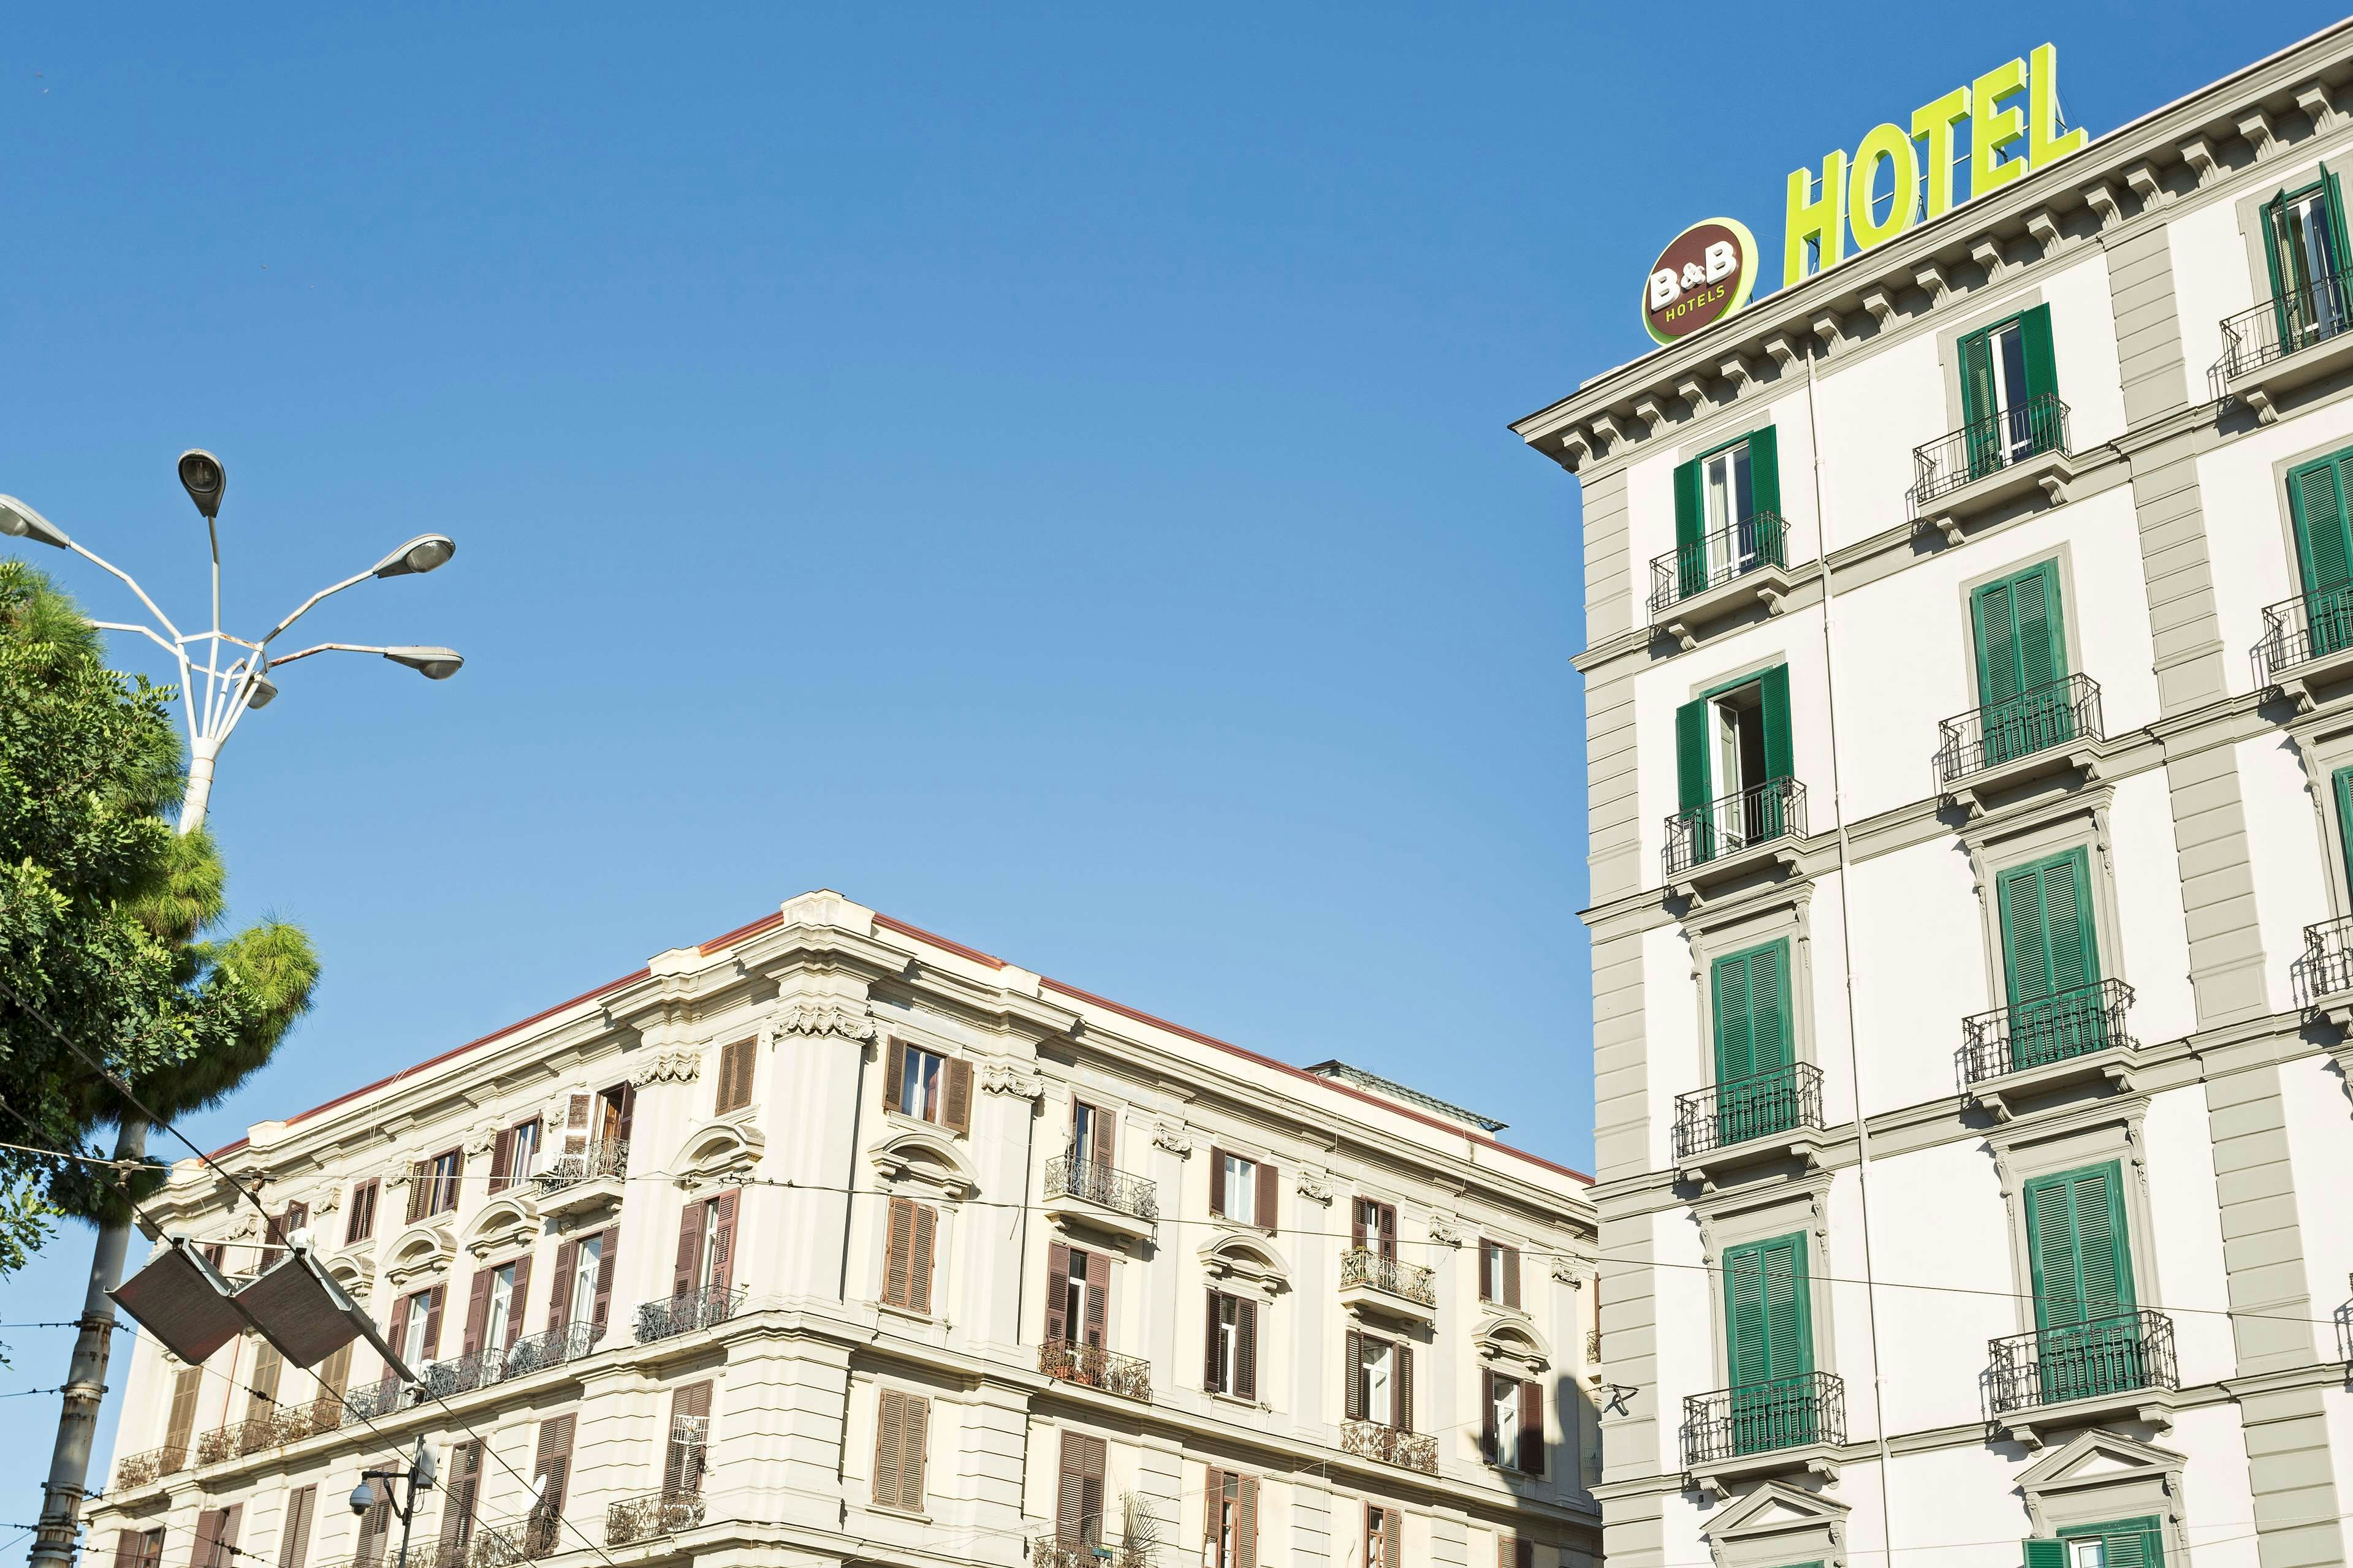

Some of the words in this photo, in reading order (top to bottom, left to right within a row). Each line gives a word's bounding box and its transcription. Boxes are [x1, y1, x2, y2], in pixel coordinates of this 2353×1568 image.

[1784, 42, 2088, 288] HOTEL
[1650, 240, 1737, 312] B&B
[1666, 285, 1725, 323] HOTELS
